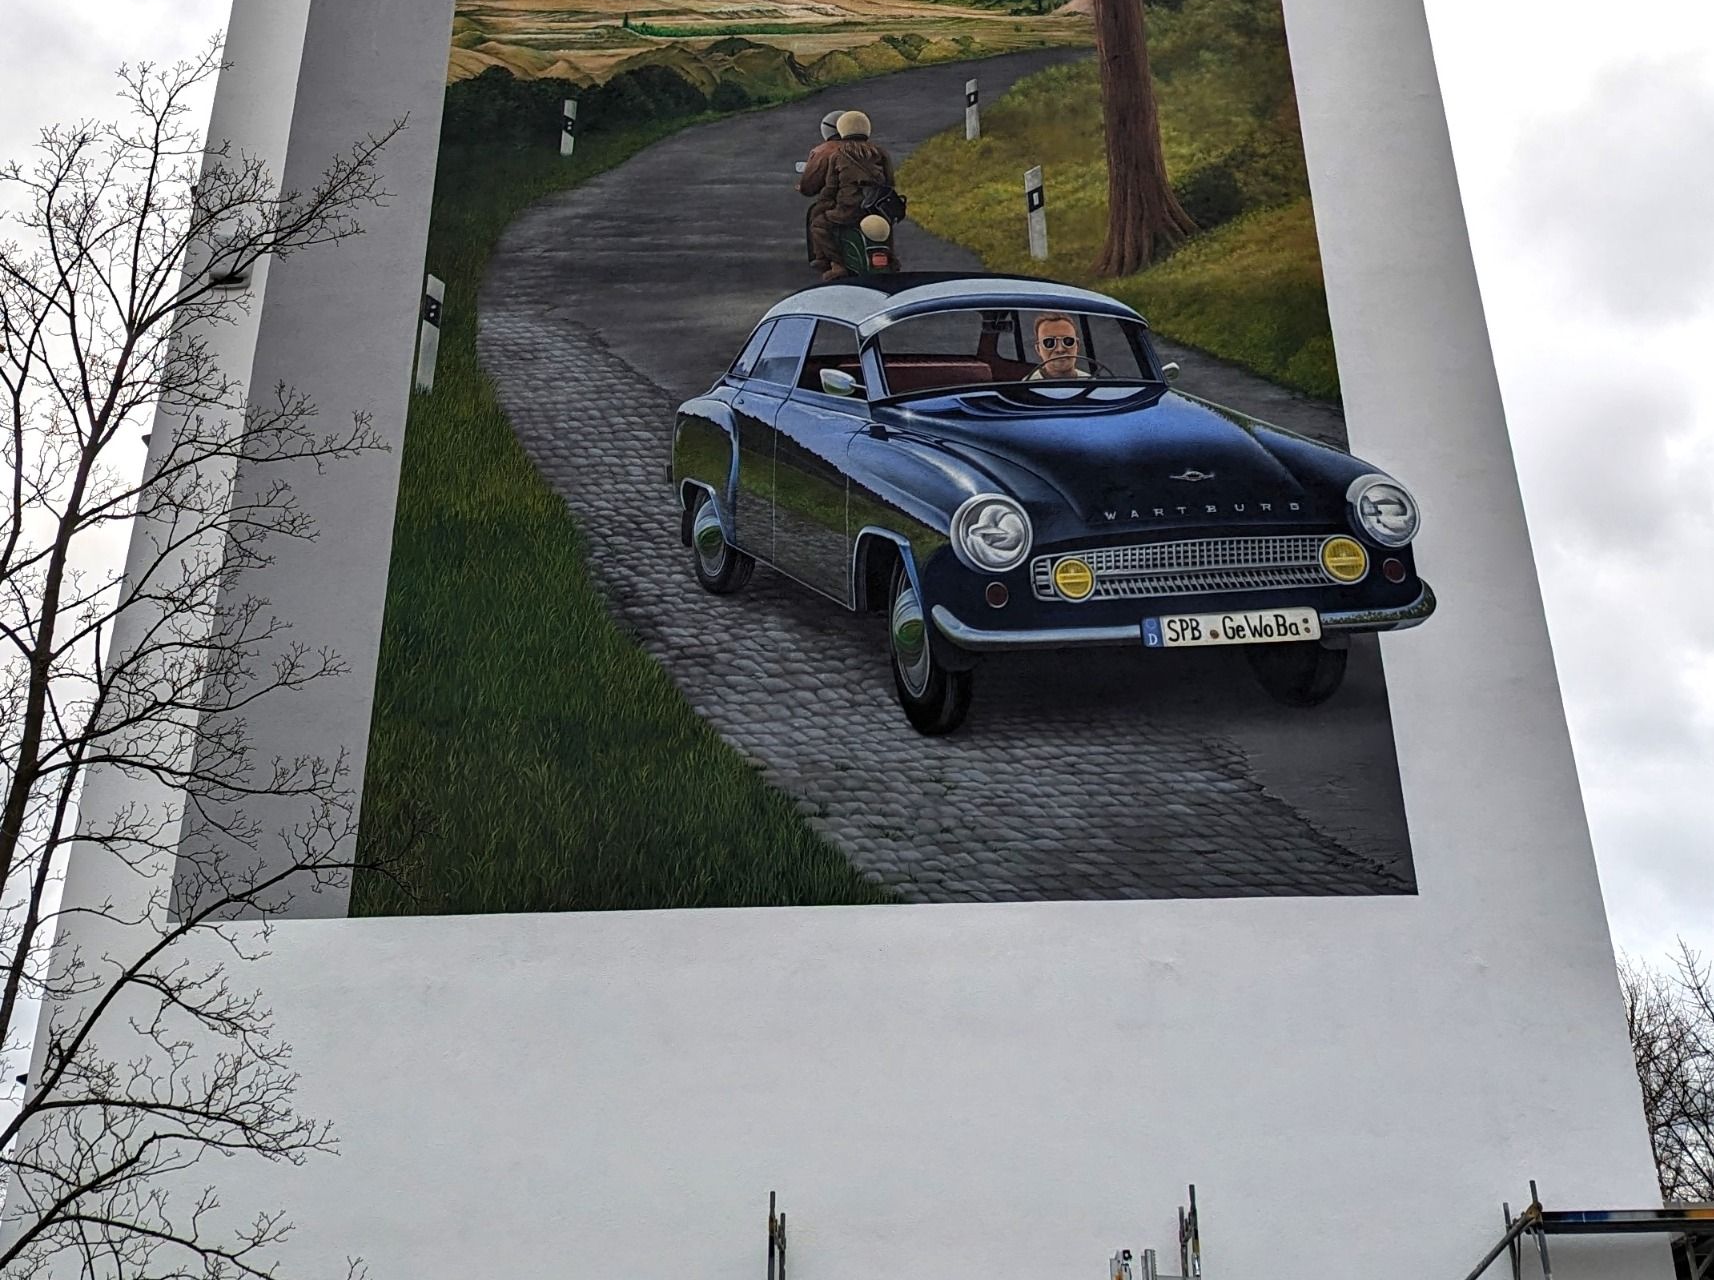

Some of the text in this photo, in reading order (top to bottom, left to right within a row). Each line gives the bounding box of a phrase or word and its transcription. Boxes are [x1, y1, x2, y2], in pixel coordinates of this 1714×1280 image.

[1104, 502, 1300, 520] WARTBURG
[1167, 618, 1202, 642] SPB
[1148, 633, 1158, 646] D
